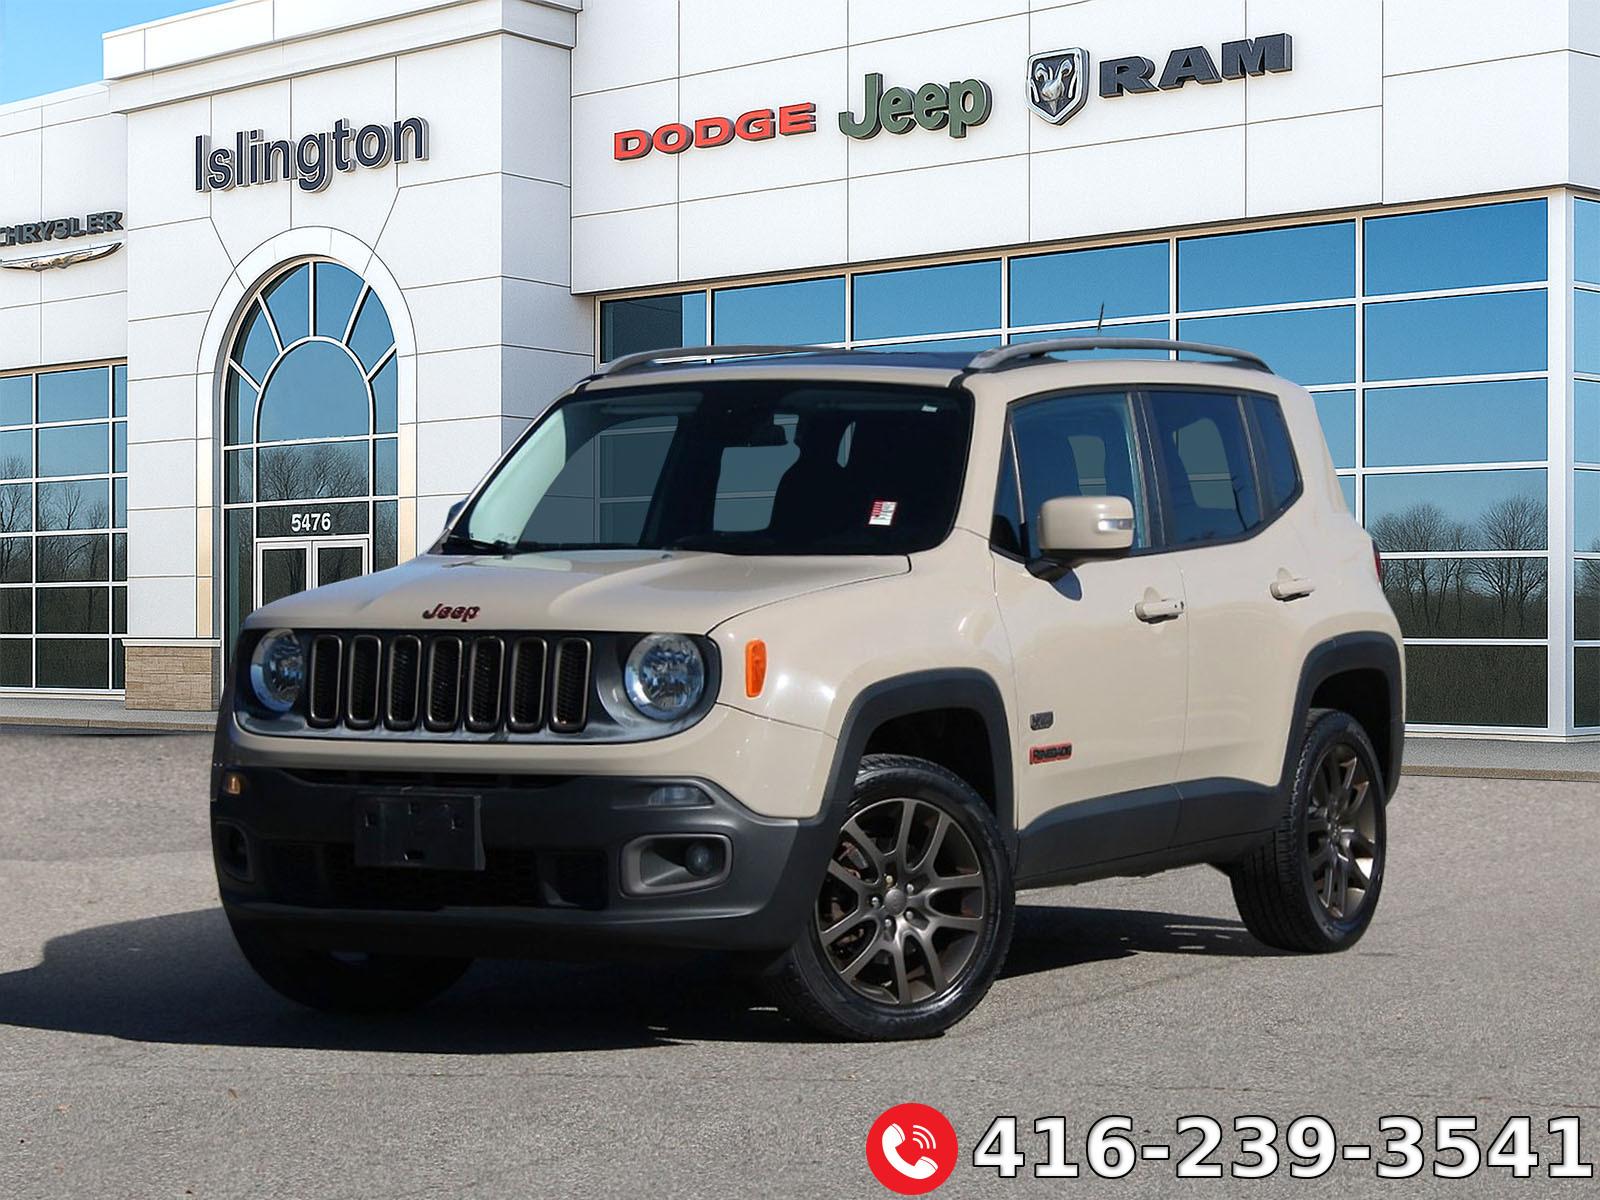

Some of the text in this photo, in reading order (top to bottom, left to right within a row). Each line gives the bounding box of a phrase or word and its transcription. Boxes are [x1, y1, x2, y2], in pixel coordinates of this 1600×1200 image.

[1099, 33, 1293, 98] RAM
[614, 102, 816, 161] DODGE
[838, 73, 992, 139] Jeep
[195, 116, 429, 192] Islington
[291, 513, 331, 532] 5476
[422, 603, 480, 622] Jeep
